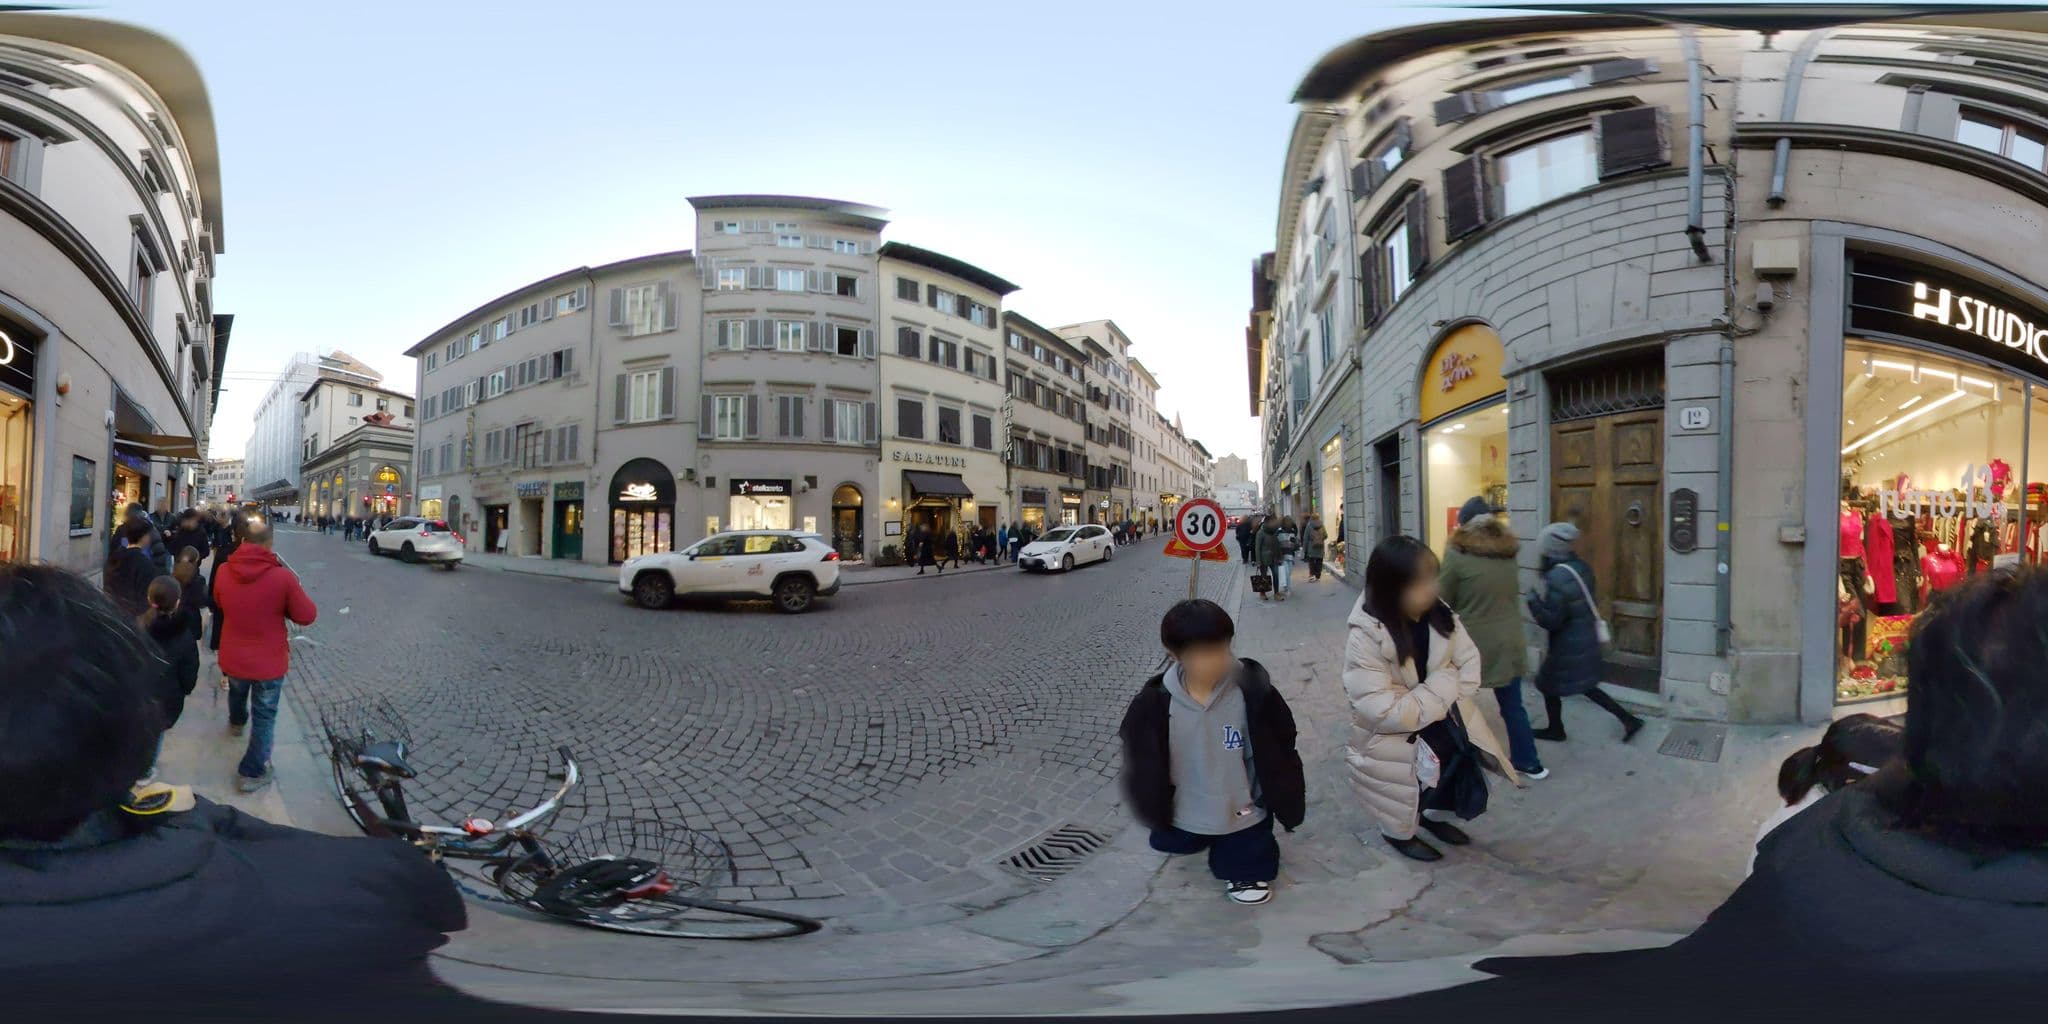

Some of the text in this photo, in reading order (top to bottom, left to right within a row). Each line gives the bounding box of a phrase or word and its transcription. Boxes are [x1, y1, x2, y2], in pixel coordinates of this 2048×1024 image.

[1913, 281, 1951, 325] H
[893, 449, 967, 469] SABATINI
[1878, 463, 1993, 520] TUTTO 13
[1187, 513, 1216, 537] 30
[1223, 725, 1244, 750] LA
